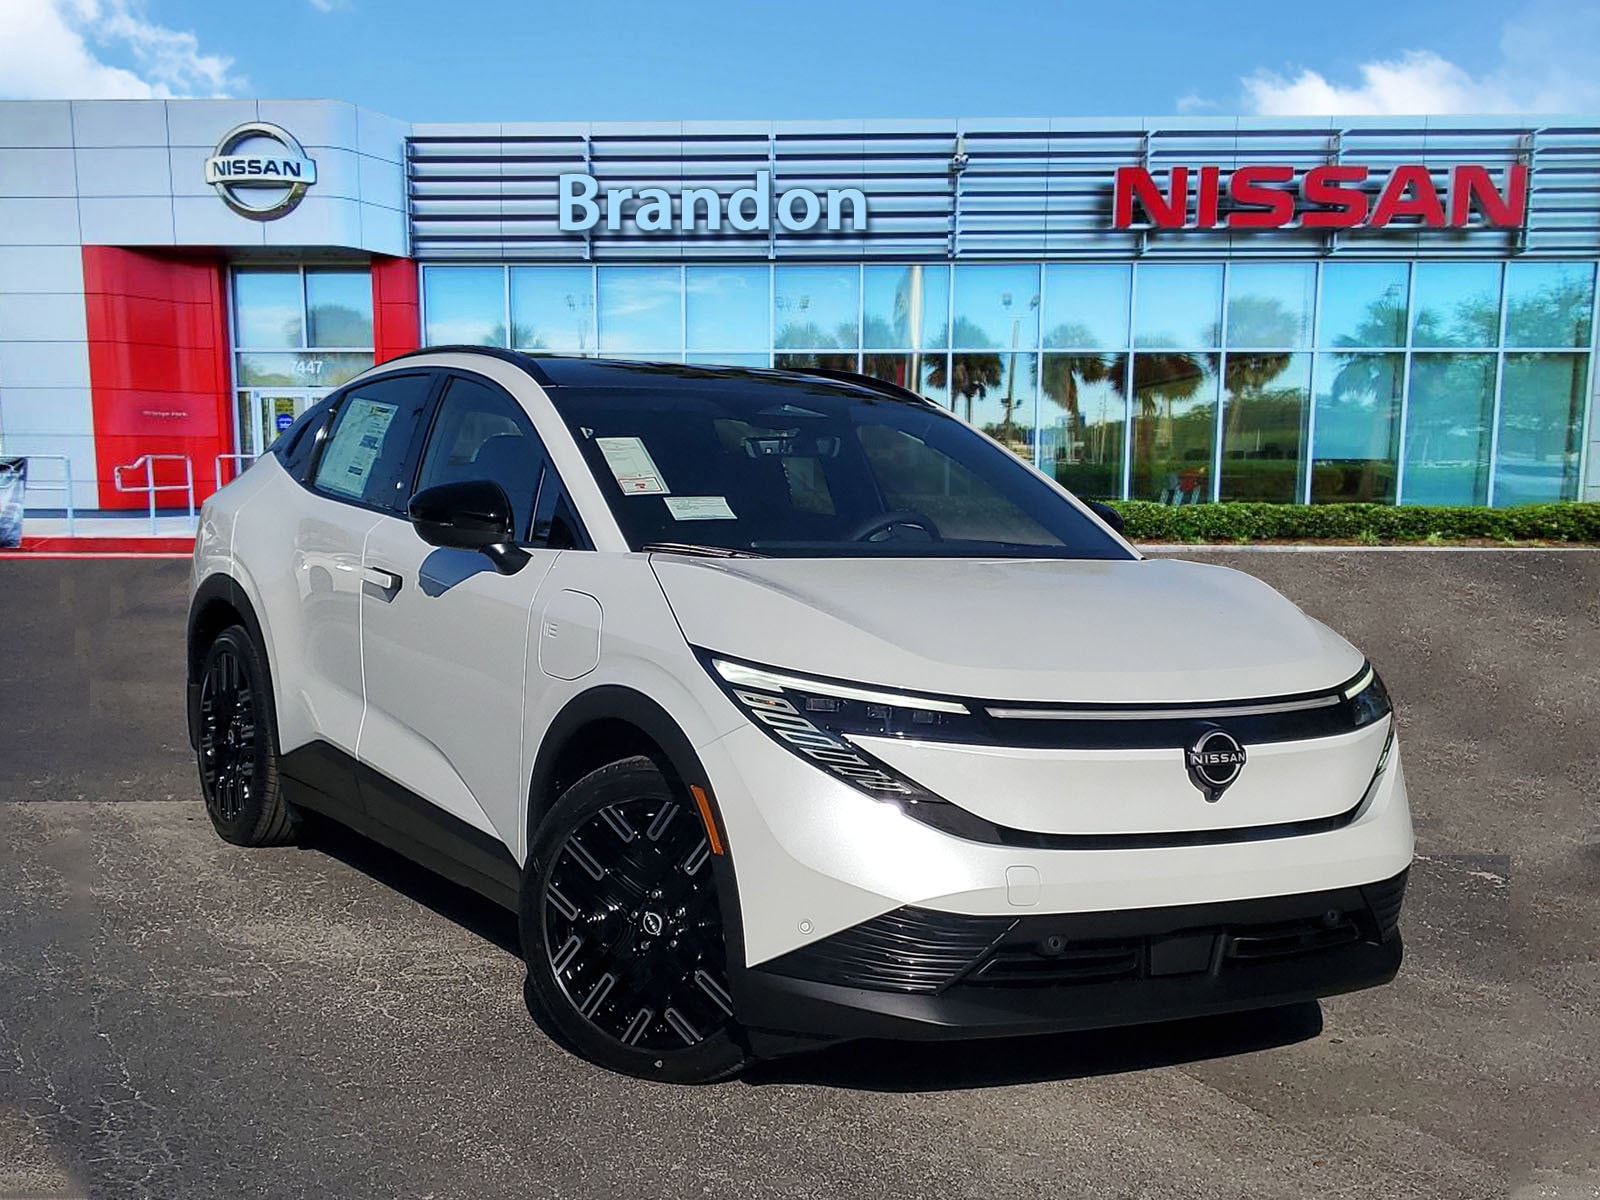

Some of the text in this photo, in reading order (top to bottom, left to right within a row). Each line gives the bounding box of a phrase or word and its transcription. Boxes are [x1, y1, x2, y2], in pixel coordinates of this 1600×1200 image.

[213, 160, 301, 177] NISSAN
[558, 170, 868, 232] Brandon
[1112, 165, 1529, 229] NISSAN
[1191, 752, 1246, 765] NISSAN
